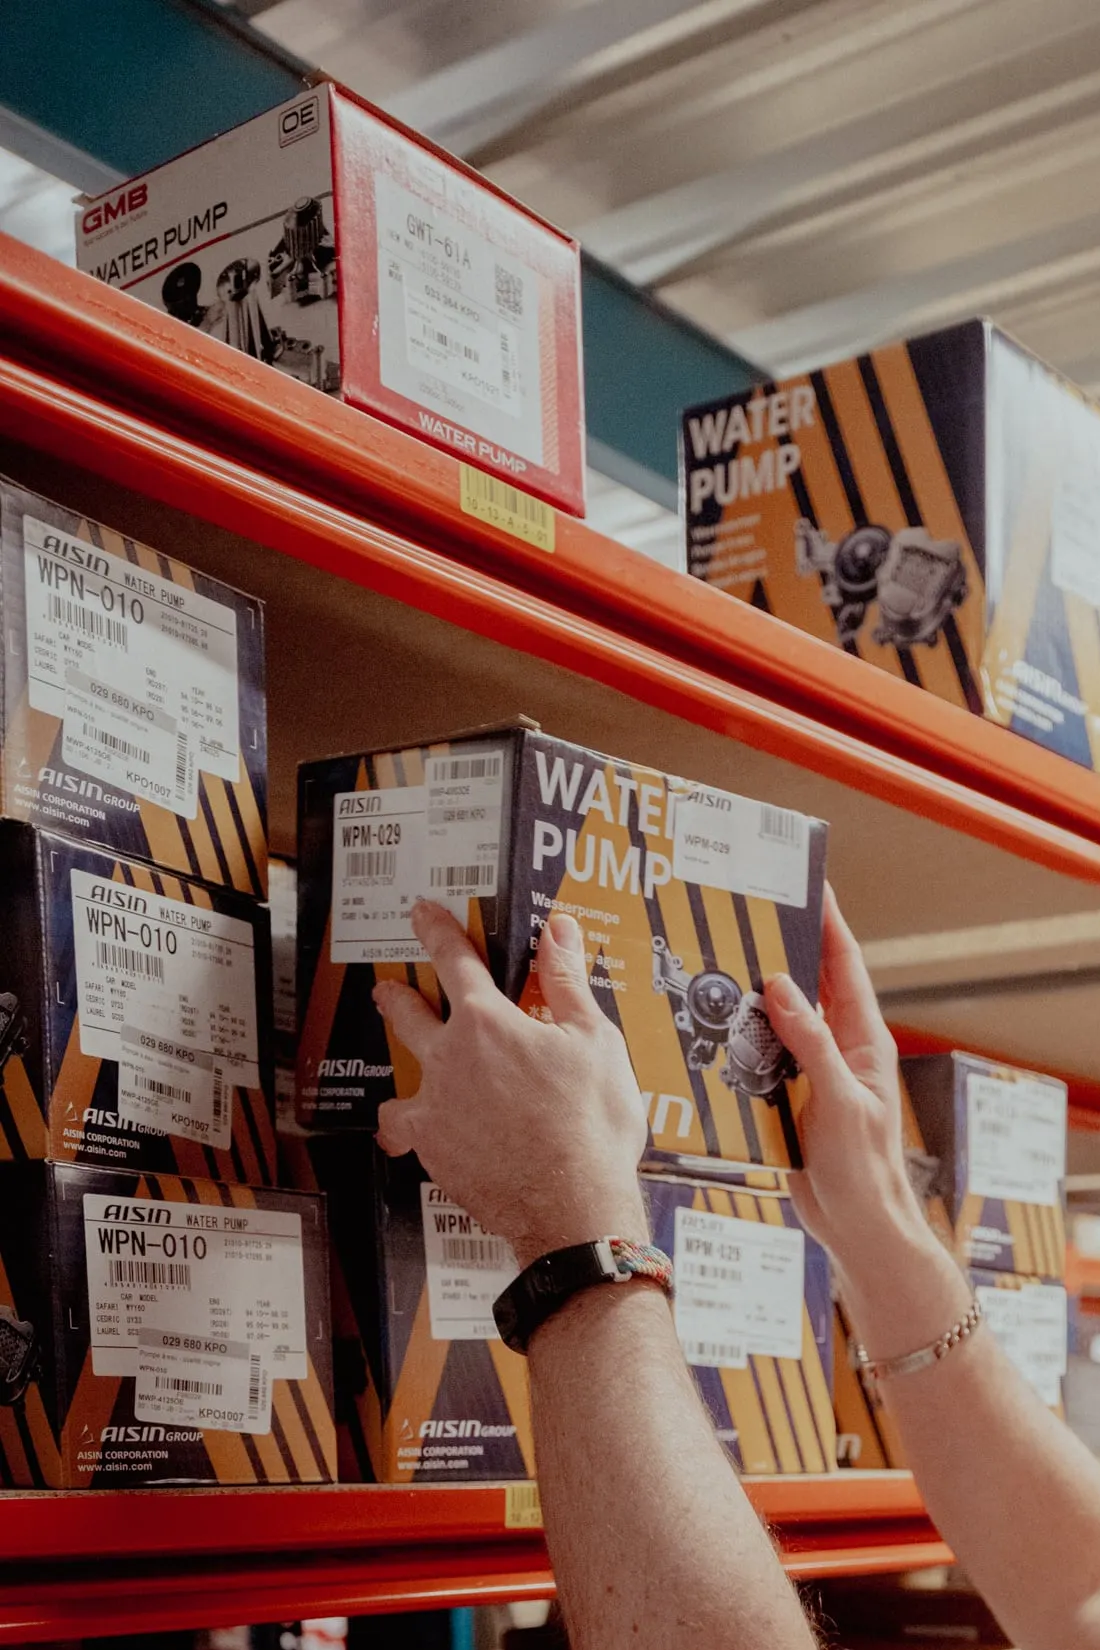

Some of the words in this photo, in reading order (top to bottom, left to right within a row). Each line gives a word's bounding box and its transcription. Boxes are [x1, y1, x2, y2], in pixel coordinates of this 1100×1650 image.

[282, 103, 314, 134] OE
[82, 183, 148, 235] GMB
[89, 237, 158, 285] WATER
[164, 202, 228, 254] PUMP
[406, 213, 471, 270] GWT-61A
[688, 387, 814, 460] WATER
[418, 411, 475, 452] WATER
[479, 445, 527, 474] PUMP
[690, 443, 799, 515] PUMP
[43, 534, 110, 576] AISIN
[124, 572, 155, 598] WATER
[161, 589, 185, 609] PUMP
[37, 554, 145, 625] WPN-010
[90, 682, 108, 699] 029
[111, 690, 129, 710] 680
[132, 700, 155, 721] KPO
[38, 767, 103, 801] AISIN
[103, 794, 140, 813] GROUP
[126, 770, 171, 798] KPO1007
[14, 784, 40, 799] AISIN
[42, 793, 106, 820] CORPORATION
[14, 798, 90, 827] www.aisin.com
[339, 796, 382, 815] AISIN
[687, 790, 733, 812] AISIN
[342, 824, 401, 848] WPM-029
[684, 833, 731, 855] WPM-029
[532, 819, 673, 899] PUMP
[91, 884, 147, 914] AISIN
[159, 906, 187, 926] WATER
[191, 916, 212, 932] PUMP
[531, 890, 620, 926] Wasserpumpe
[86, 906, 177, 955] WPN-010
[587, 930, 610, 945] eau
[384, 946, 429, 958] CORPORAT
[596, 954, 626, 970] agua
[140, 1034, 156, 1049] 029
[158, 1041, 174, 1055] 680
[176, 1048, 195, 1063] KPO
[317, 1058, 365, 1077] AISIN
[363, 1065, 394, 1077] GROUP
[171, 1112, 210, 1132] KPO1007
[63, 1127, 85, 1140] AISIN
[86, 1132, 140, 1149] CORPORATION
[63, 1140, 127, 1159] www.aisin.com
[104, 1204, 172, 1225] AISIN
[186, 1214, 219, 1229] WATER
[224, 1217, 249, 1231] PUMP
[98, 1227, 208, 1260] WPN-010
[96, 1314, 120, 1324] CEDRIC
[97, 1327, 120, 1336] LAUREL
[162, 1335, 180, 1347] 029
[184, 1338, 202, 1350] 680
[204, 1341, 228, 1354] KPO
[100, 1426, 165, 1442] AISIN
[165, 1432, 204, 1442] GROUP
[419, 1419, 482, 1439] AISIN
[77, 1451, 102, 1460] AISIN
[105, 1450, 168, 1460] CORPORATION
[423, 1445, 484, 1457] CORPORATION
[77, 1462, 153, 1473] www.aisin.com
